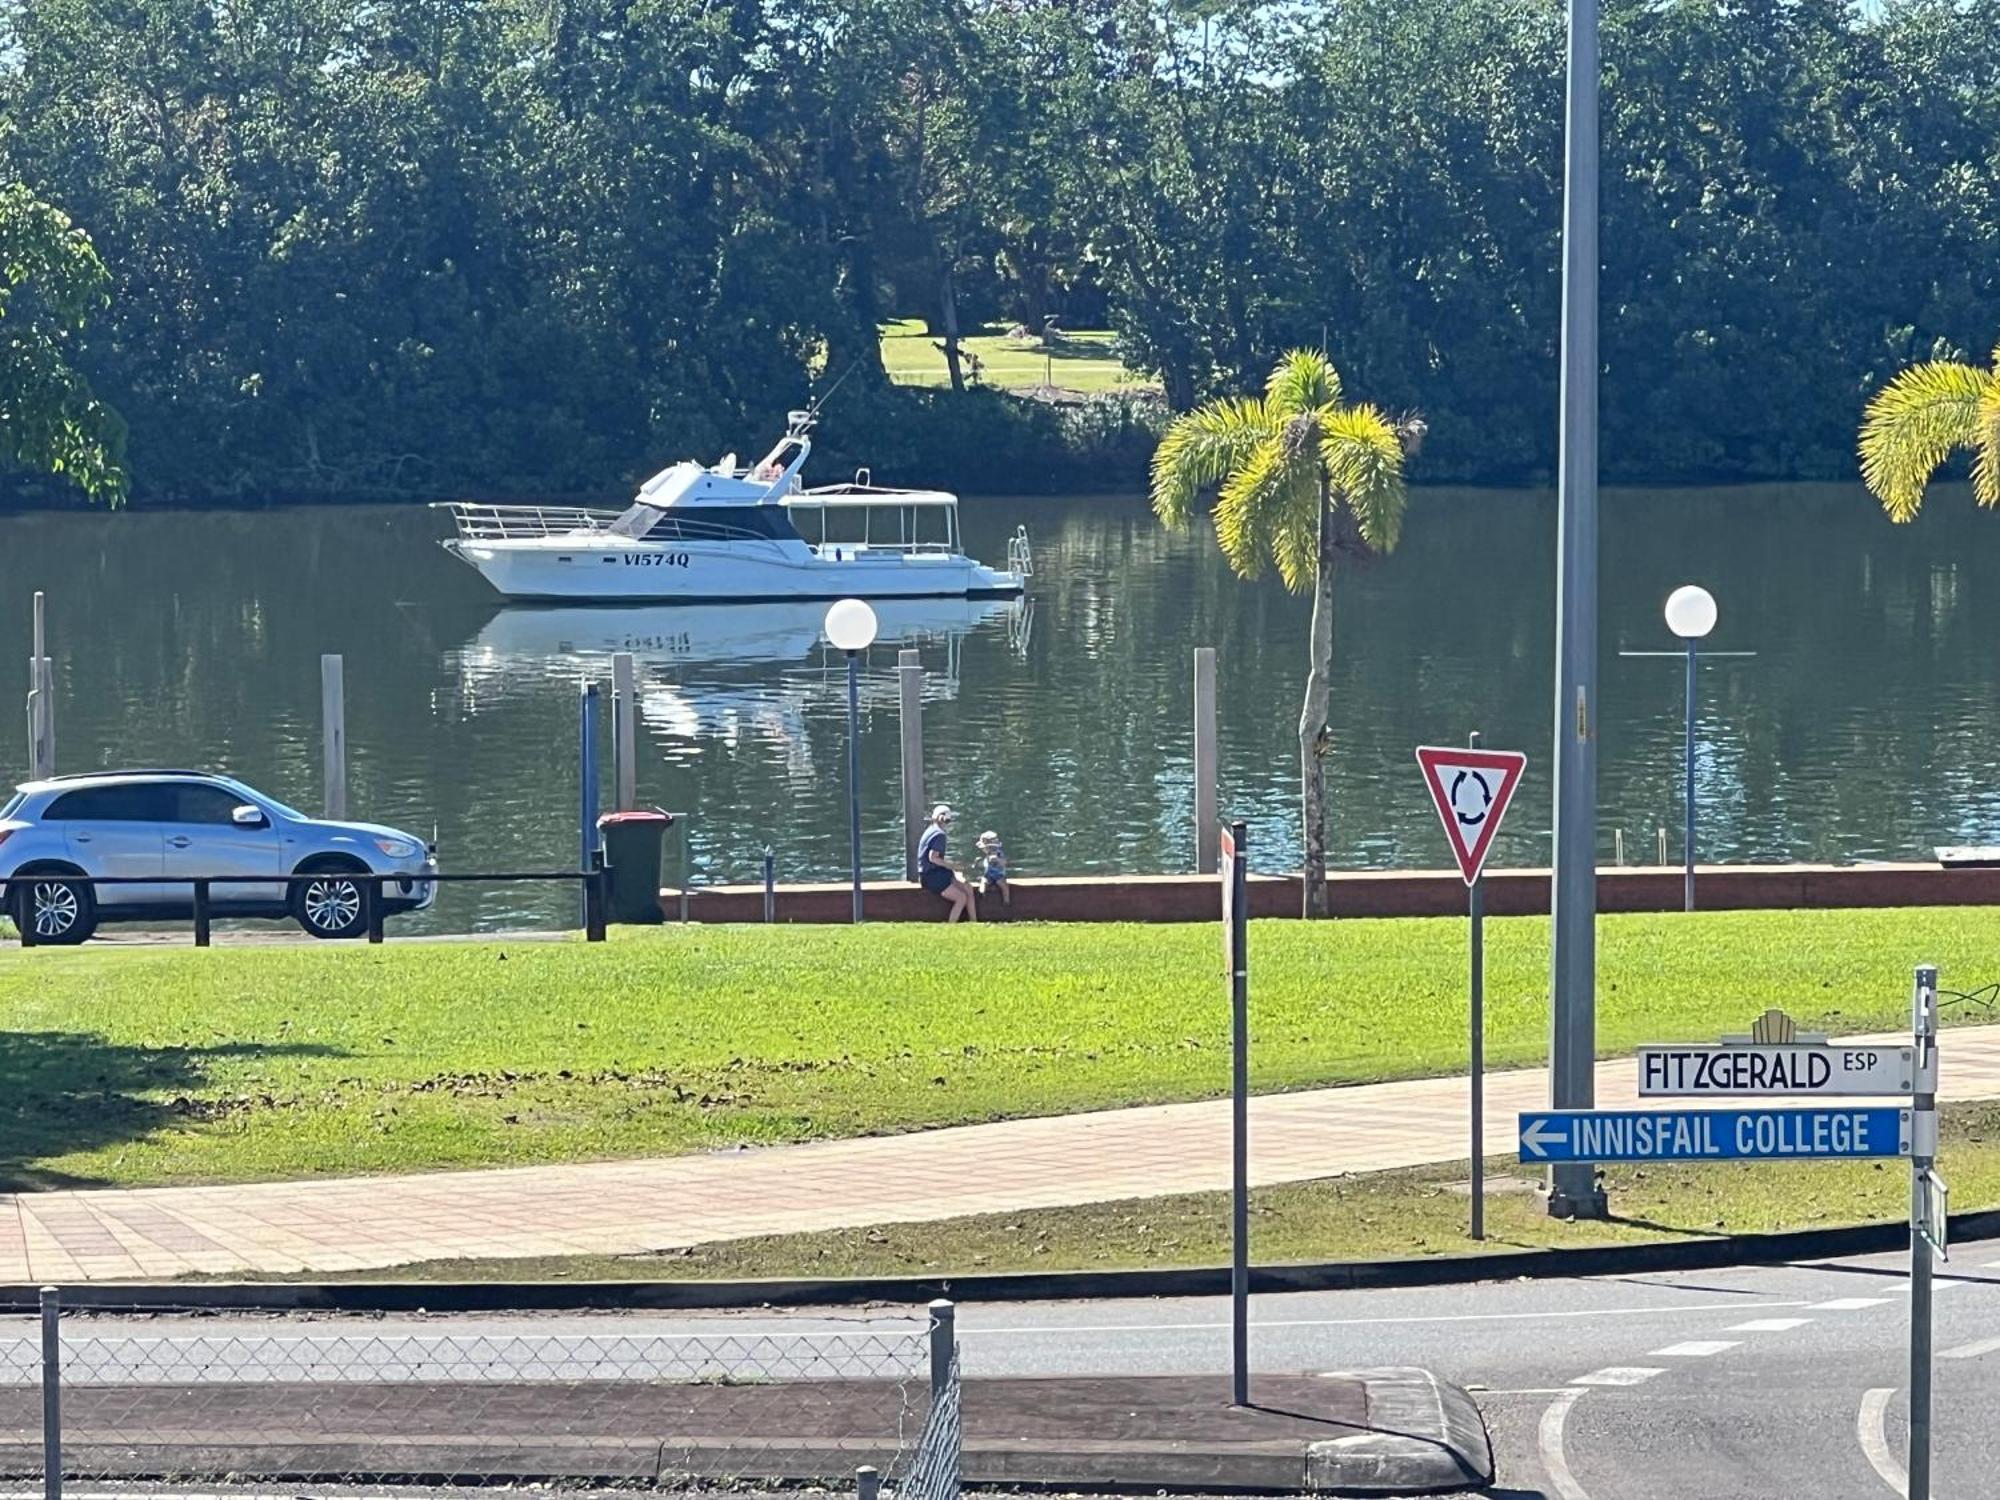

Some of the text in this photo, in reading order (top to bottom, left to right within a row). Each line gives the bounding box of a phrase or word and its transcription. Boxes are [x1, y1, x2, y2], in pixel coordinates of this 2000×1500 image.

[624, 553, 689, 568] VI574Q
[1645, 1052, 1878, 1089] FITZGERALD ESP
[1573, 1114, 1869, 1156] INNISFAIL COLLEGE
